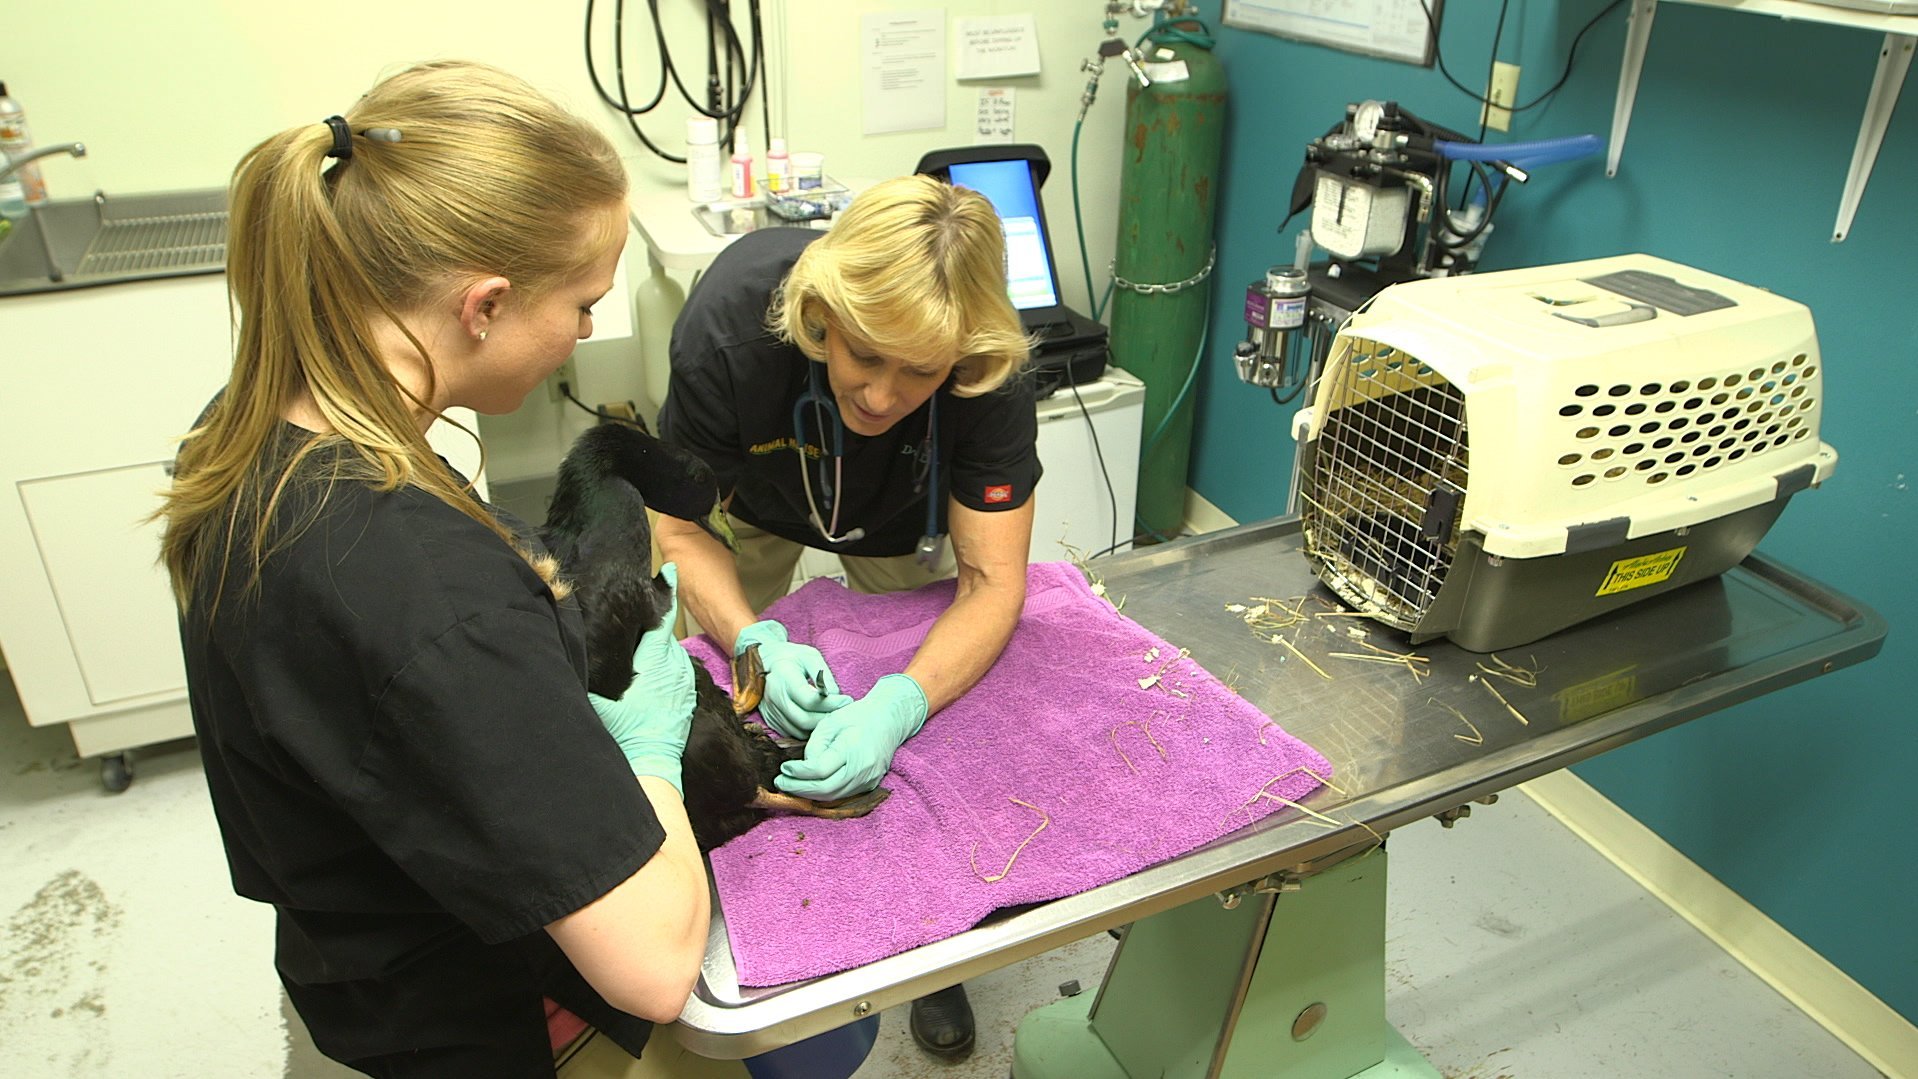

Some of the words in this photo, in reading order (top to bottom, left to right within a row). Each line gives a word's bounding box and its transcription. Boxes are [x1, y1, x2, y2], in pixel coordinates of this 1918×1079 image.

[749, 437, 787, 453] ANIMAL
[788, 437, 820, 458] HSE
[1615, 570, 1635, 583] THIS
[1635, 565, 1656, 579] SIDE
[1656, 562, 1670, 574] UP
